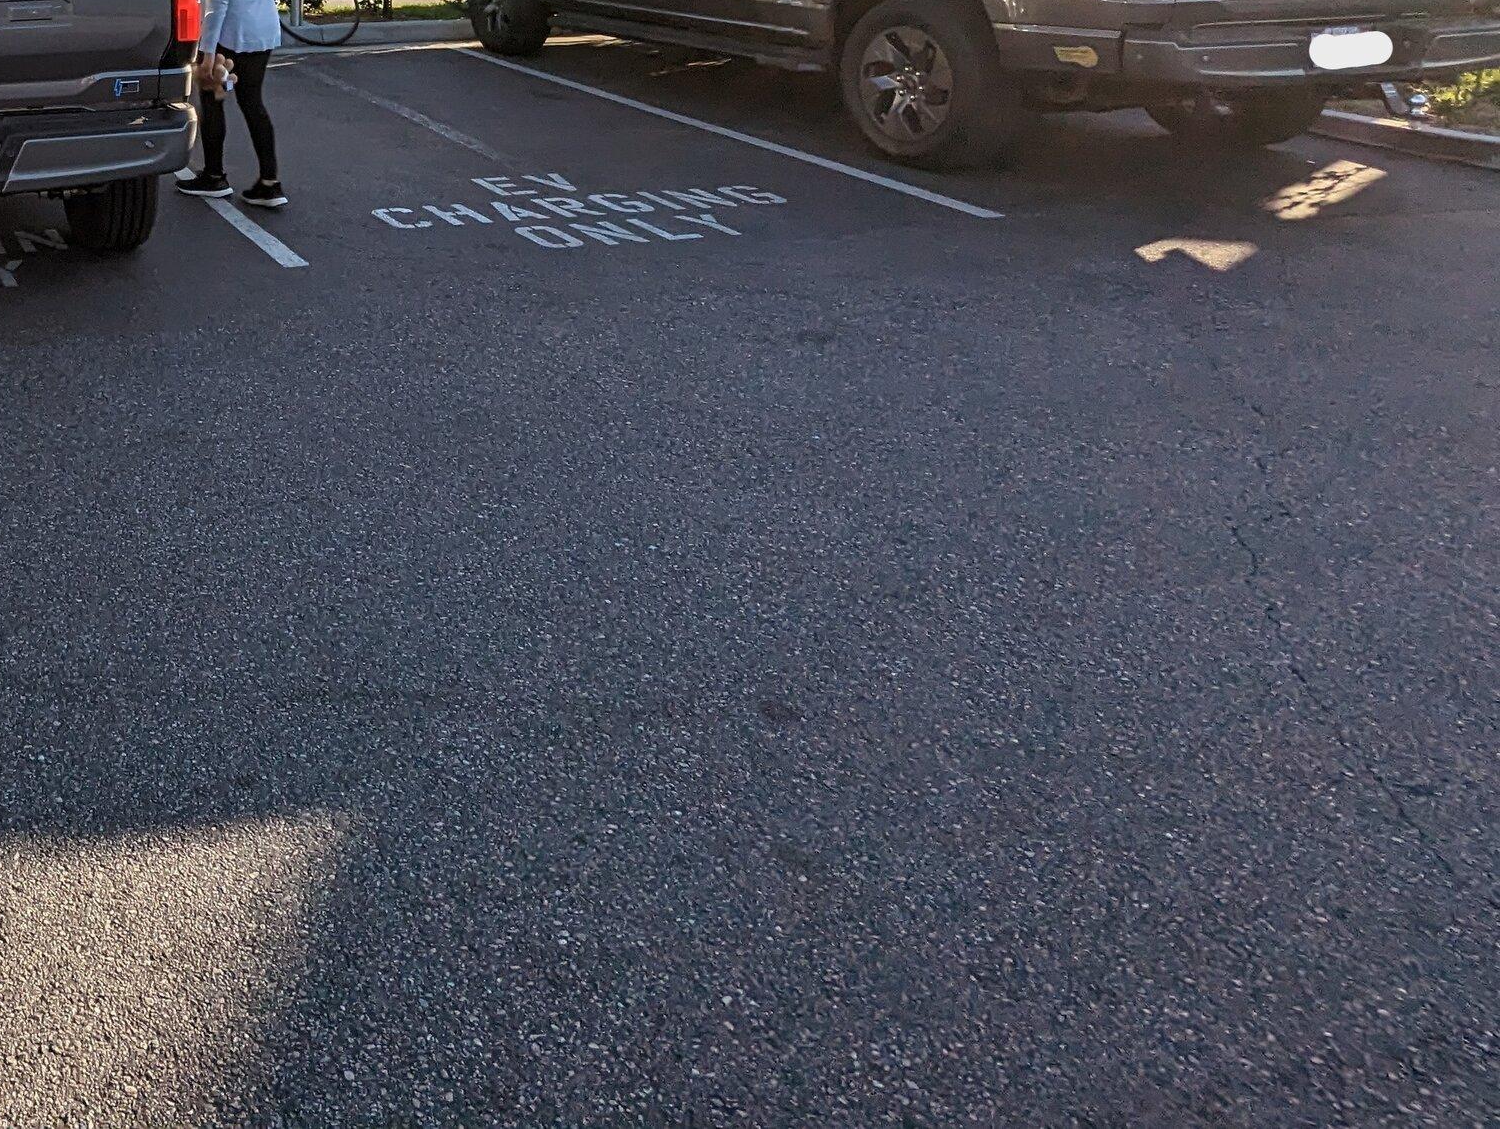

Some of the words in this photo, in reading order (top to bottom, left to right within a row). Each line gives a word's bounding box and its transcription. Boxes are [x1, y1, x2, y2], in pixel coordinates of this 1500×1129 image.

[471, 173, 577, 196] EV
[371, 185, 788, 229] CHARGING
[514, 214, 743, 249] ONLY
